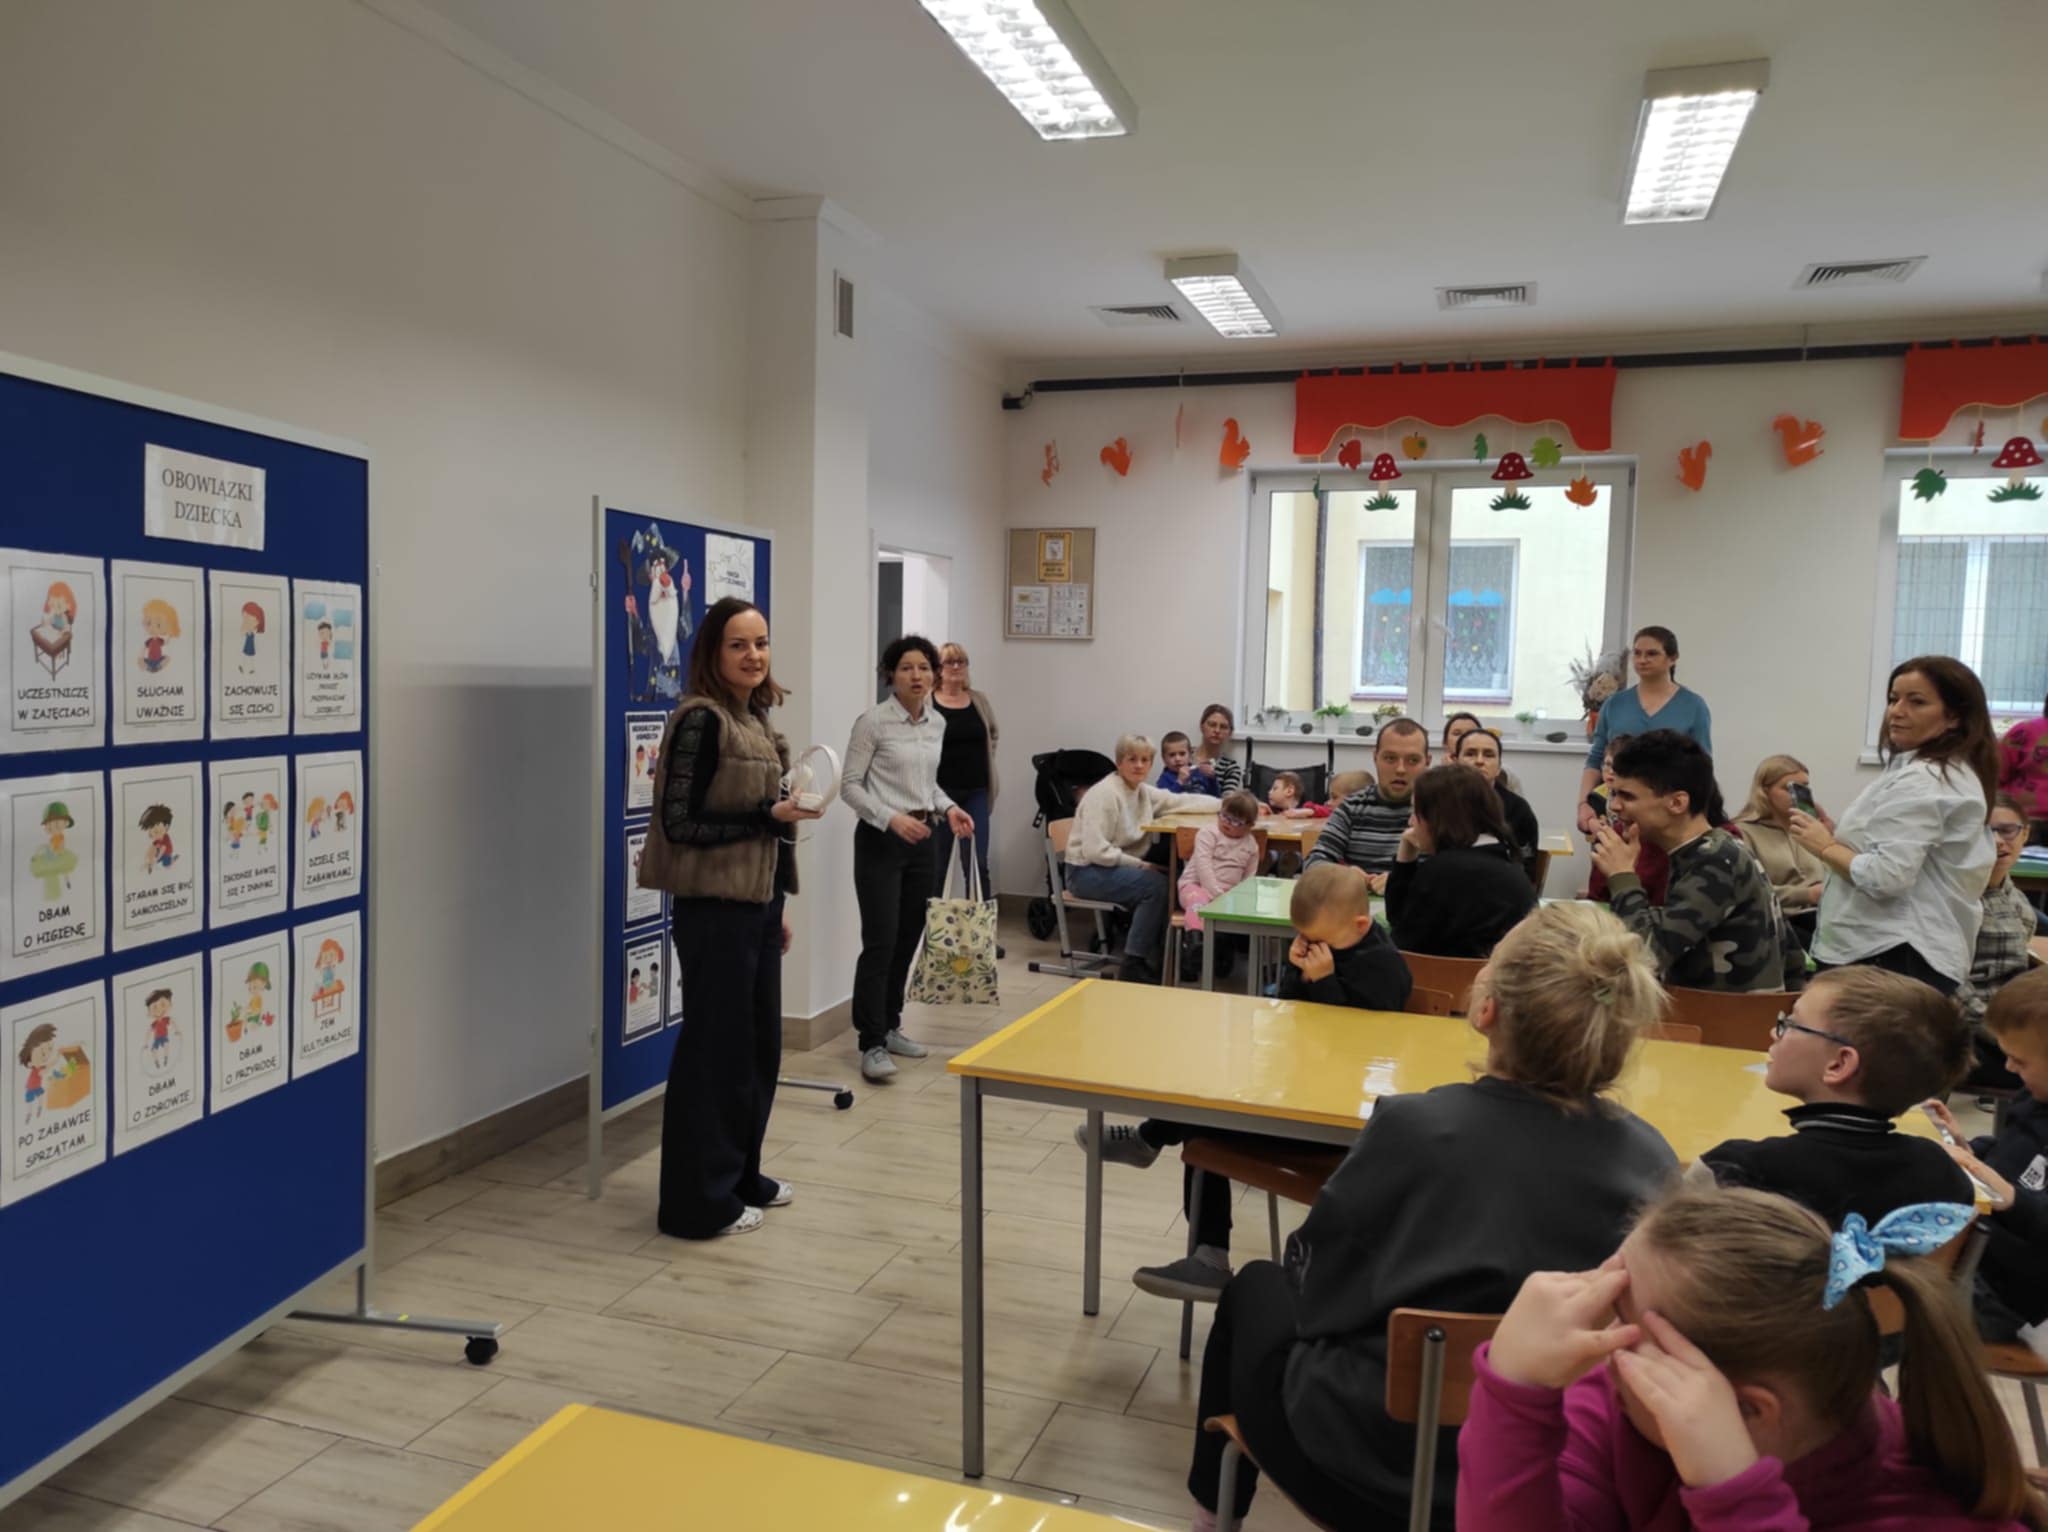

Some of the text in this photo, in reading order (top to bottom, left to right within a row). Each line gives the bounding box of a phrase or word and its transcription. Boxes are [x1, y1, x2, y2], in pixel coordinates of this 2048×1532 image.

[162, 467, 253, 502] OBOWIĄZKI
[174, 500, 243, 529] DZIECKA
[17, 686, 89, 701] UCZESTNICZĘ
[137, 685, 184, 698] SŁUCHAM
[224, 684, 279, 697] ZACHOWUJĘ
[17, 706, 90, 720] W ZAJĘCIACH
[136, 704, 184, 719] UWAŻNIE
[229, 703, 274, 716] SIĘ CICHO
[124, 888, 159, 904] STARAM
[161, 883, 177, 896] SIĘ
[38, 904, 71, 923] DBAM
[23, 921, 87, 949] O HIGIENĘ
[238, 1044, 264, 1061] DBAM
[148, 1077, 177, 1097] DBAM
[225, 1074, 233, 1085] O
[132, 1111, 142, 1123] O
[18, 1108, 92, 1150] PO ZABAWIE
[25, 1133, 86, 1169] SPRZĄTAM
